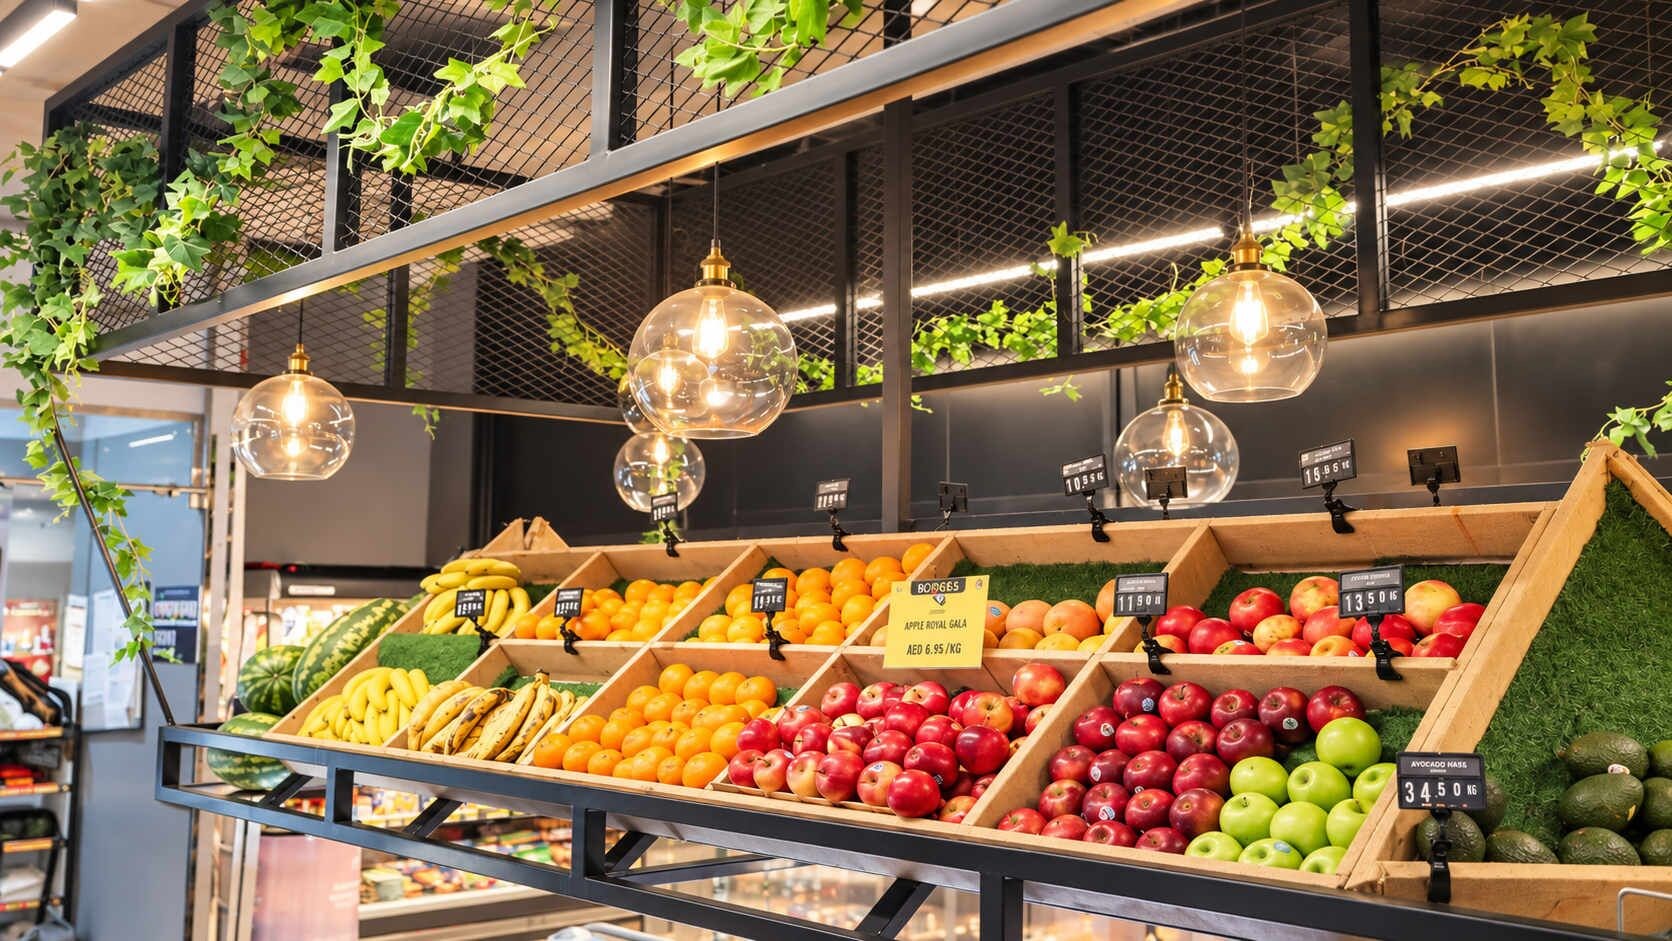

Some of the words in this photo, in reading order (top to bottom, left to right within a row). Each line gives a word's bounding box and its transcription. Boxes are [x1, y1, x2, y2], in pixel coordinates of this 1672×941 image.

[904, 621, 924, 631] APPLE
[926, 620, 947, 630] ROYAL
[949, 619, 967, 629] GALA
[906, 644, 923, 656] AED
[925, 643, 944, 655] 6.95
[1410, 760, 1446, 769] AVOCADO
[1404, 781, 1461, 803] 34.50
